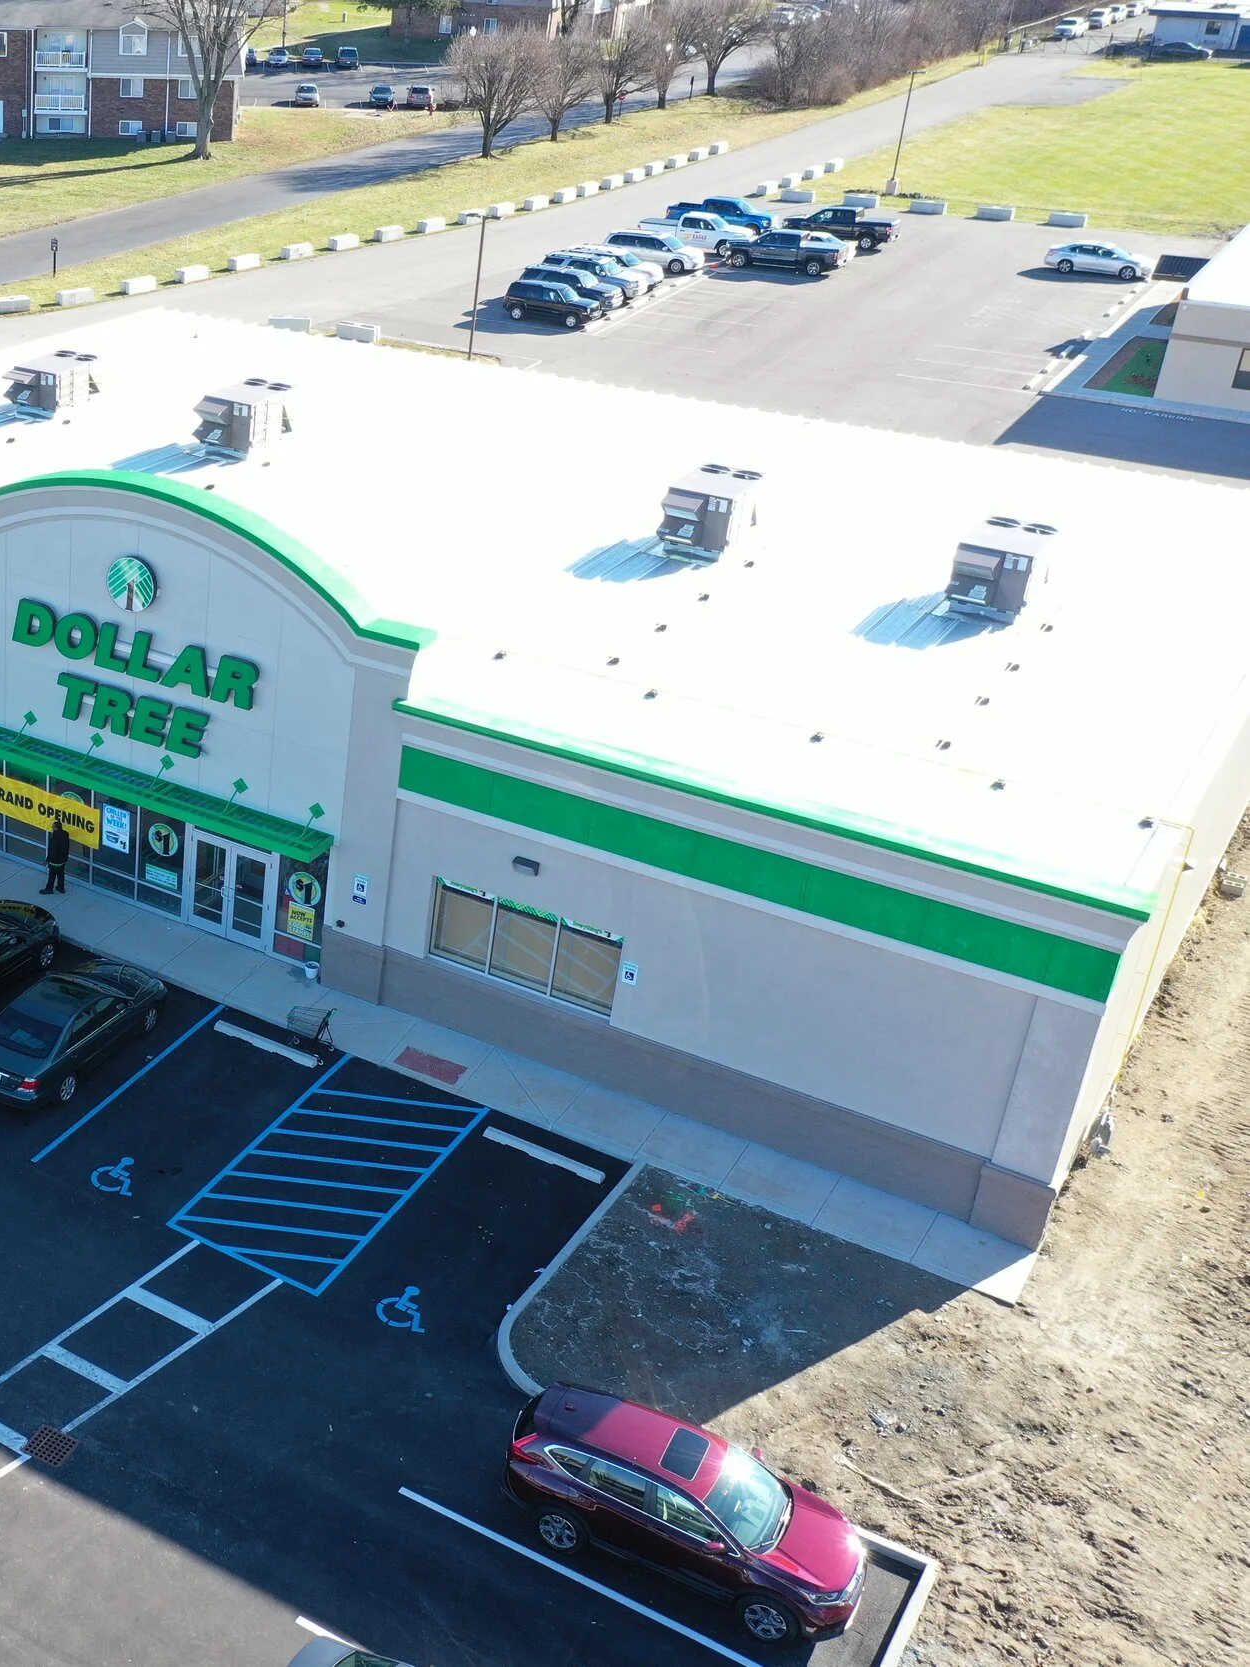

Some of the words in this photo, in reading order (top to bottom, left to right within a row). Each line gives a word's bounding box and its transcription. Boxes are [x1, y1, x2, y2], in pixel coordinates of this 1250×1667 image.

[1144, 411, 1195, 422] PARKING
[12, 598, 260, 711] DOLLAR
[57, 672, 210, 759] TREE
[38, 803, 95, 833] OPENING
[155, 830, 170, 855] $1
[295, 878, 313, 905] $1
[290, 914, 312, 923] ACCEPTS
[292, 909, 306, 917] NOW
